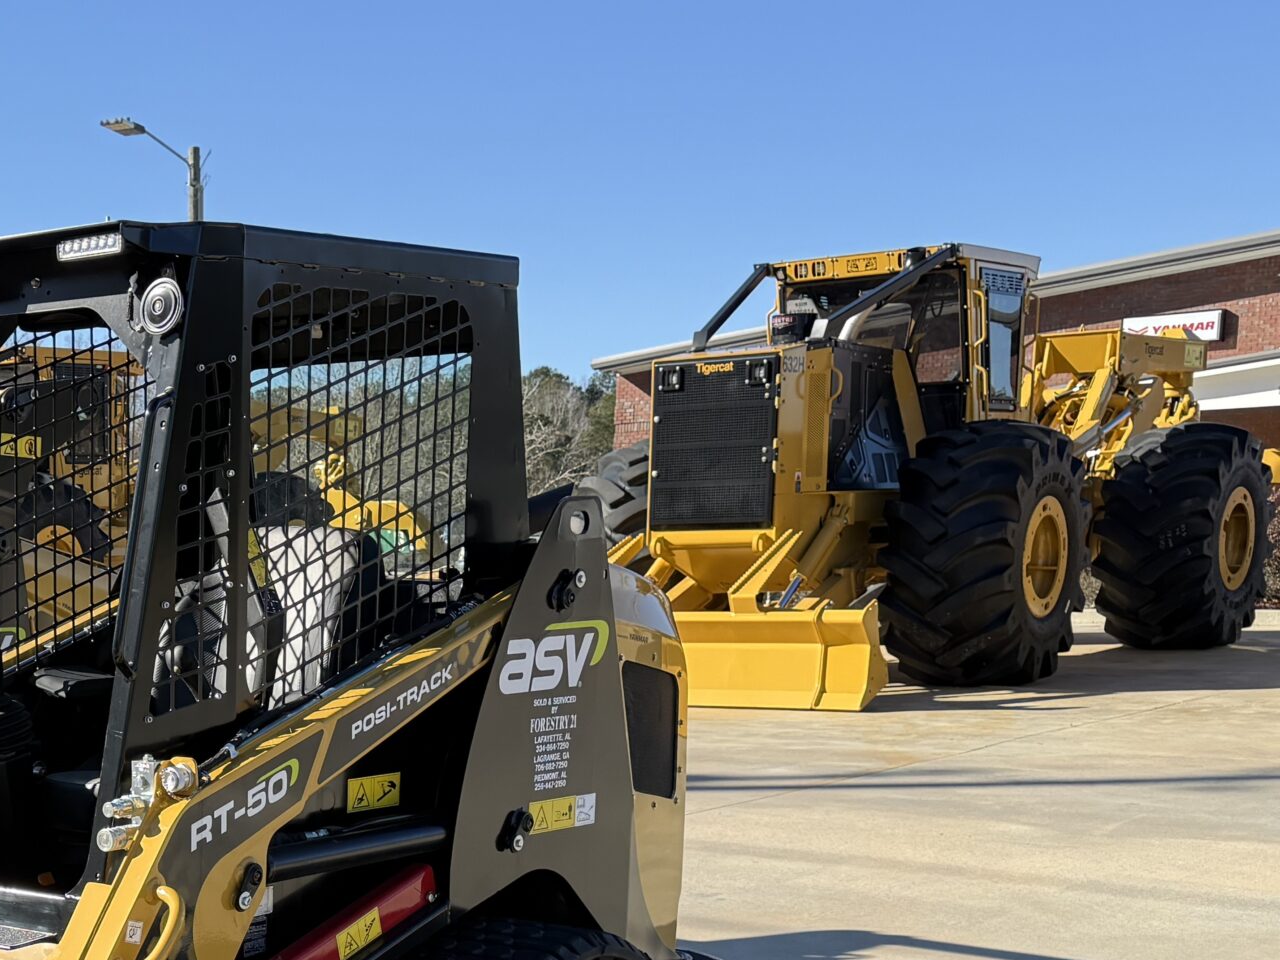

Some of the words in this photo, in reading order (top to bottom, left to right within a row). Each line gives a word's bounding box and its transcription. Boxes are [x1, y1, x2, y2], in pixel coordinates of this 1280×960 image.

[696, 361, 734, 375] Tigercat
[783, 356, 805, 373] 632H
[351, 663, 454, 740] POSI-TRACK
[533, 698, 547, 707] SOLD
[552, 695, 577, 705] SERVICED
[551, 706, 558, 714] BY
[530, 714, 570, 733] FORESTRY
[569, 714, 577, 729] 21
[190, 769, 288, 853] RT-50
